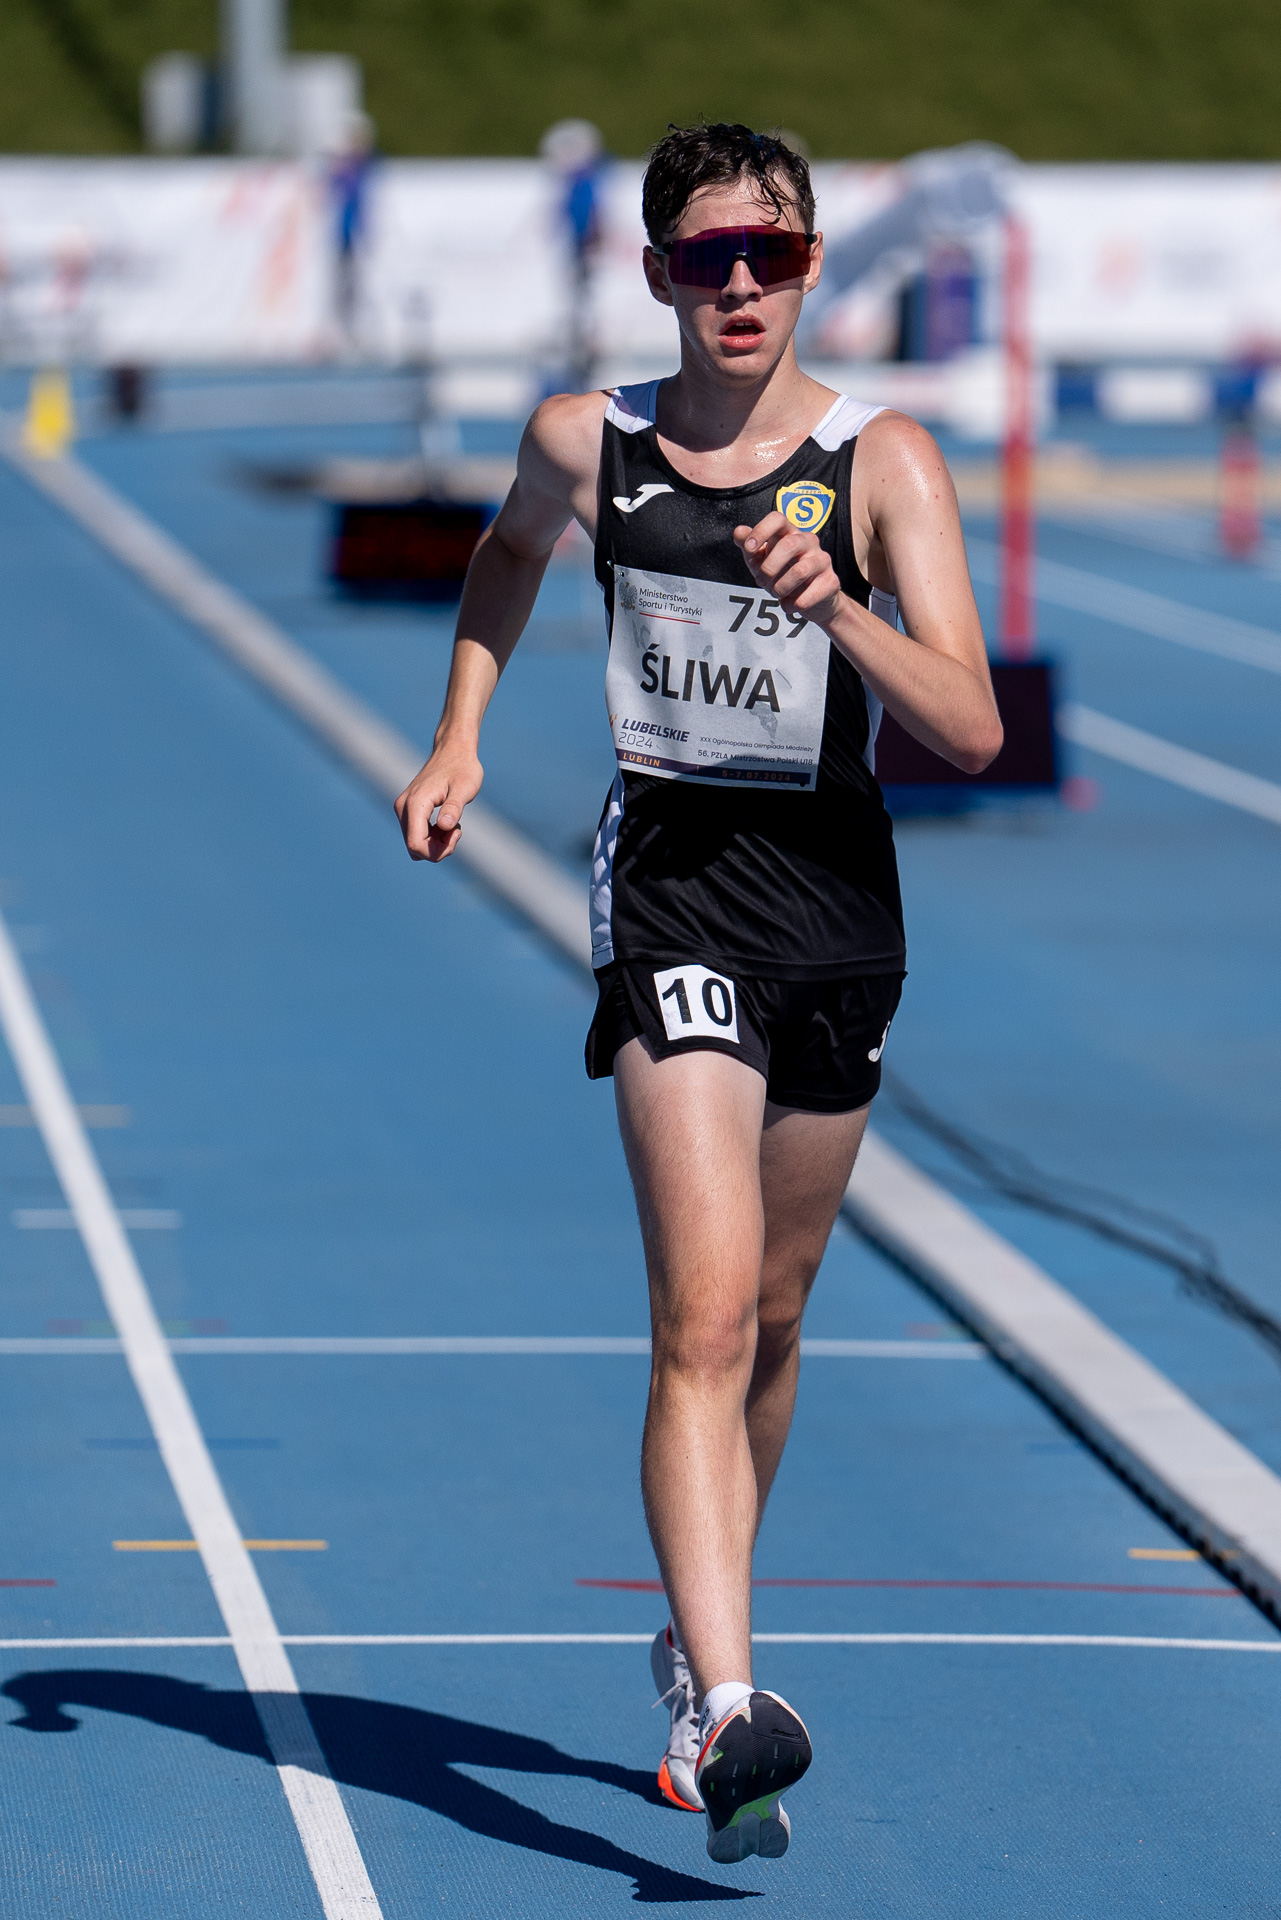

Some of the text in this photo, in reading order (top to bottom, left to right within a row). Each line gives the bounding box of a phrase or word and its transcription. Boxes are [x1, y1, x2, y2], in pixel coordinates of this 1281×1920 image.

[795, 497, 814, 522] S
[639, 587, 689, 604] Ministerstwo
[638, 597, 703, 617] Sportu i Turystyki
[728, 595, 809, 639] 759
[640, 643, 781, 713] ŚLIWA
[618, 731, 653, 749] 2024
[621, 718, 690, 743] LUBELSKIE
[753, 742, 785, 751] Olimpiada
[623, 752, 661, 768] LUBLIN
[697, 749, 813, 766] 56. PZLA Mistrzostwa Polski U18
[721, 769, 791, 782] 5-7.07.2024
[661, 977, 733, 1027] 10
